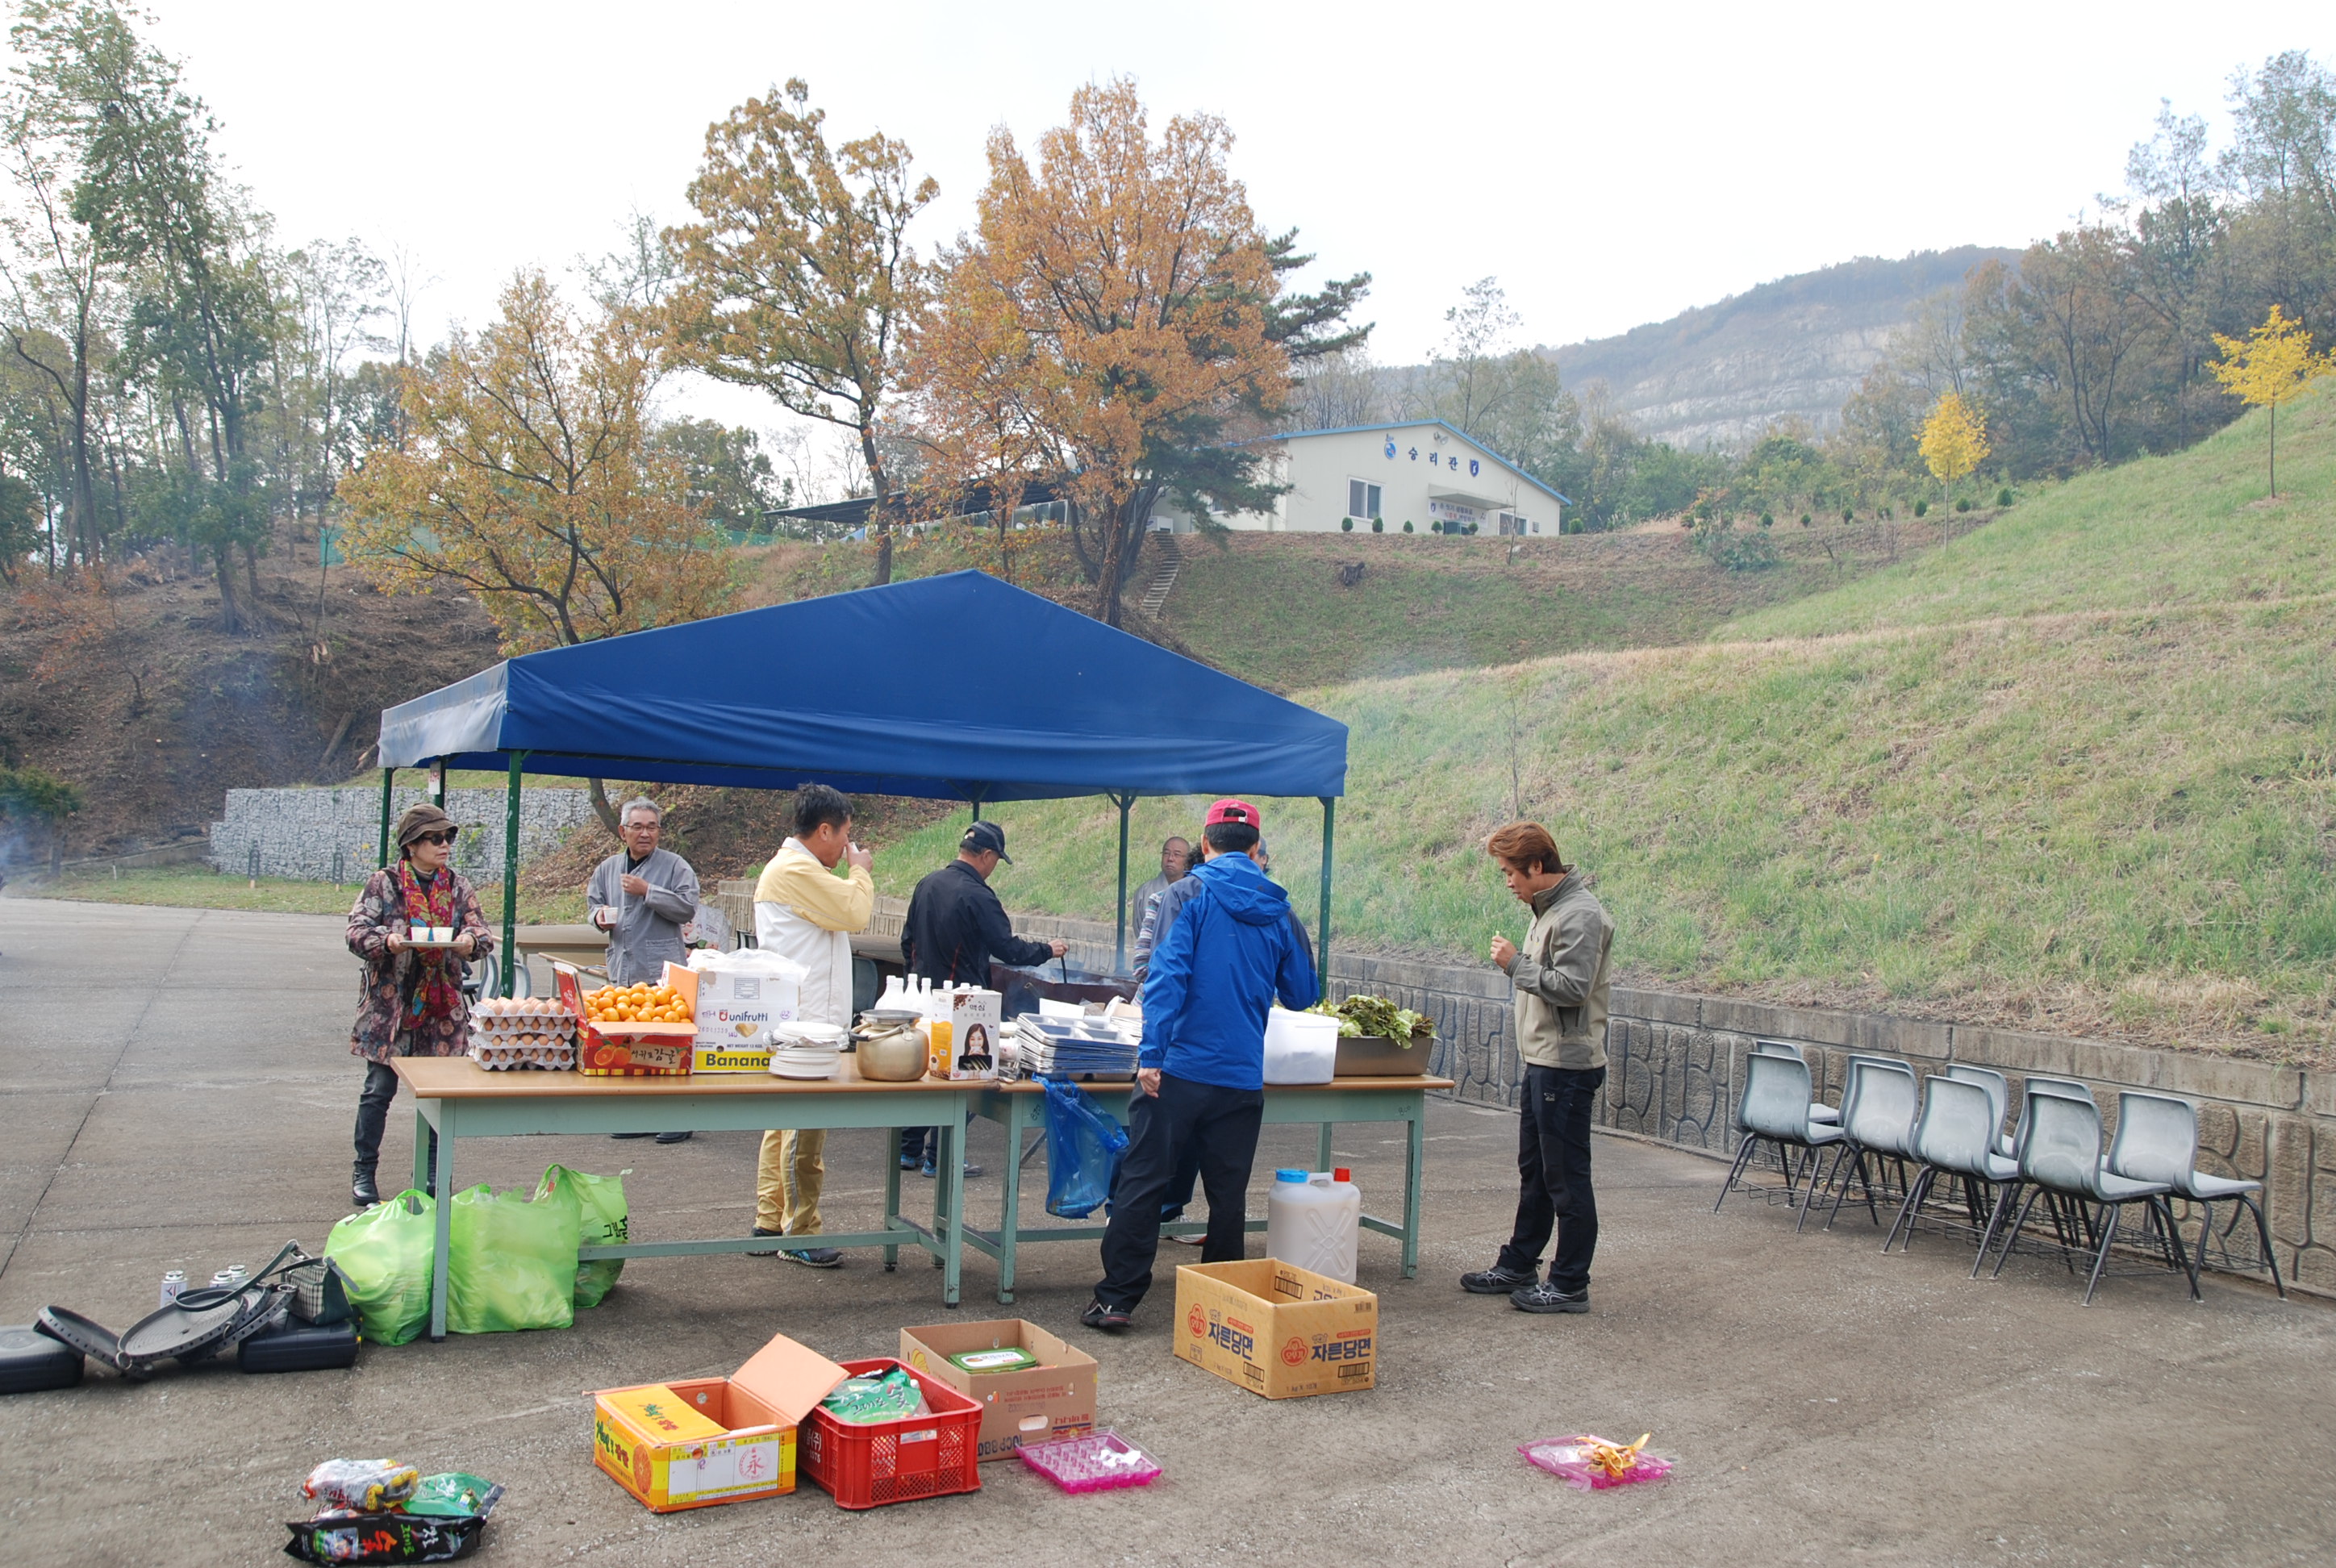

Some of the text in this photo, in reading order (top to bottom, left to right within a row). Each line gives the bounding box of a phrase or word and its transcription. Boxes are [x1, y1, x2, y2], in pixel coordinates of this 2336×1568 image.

[729, 1011, 768, 1022] unifrutti
[1208, 1322, 1254, 1362] 자른당면
[1311, 1337, 1371, 1362] 자른당면
